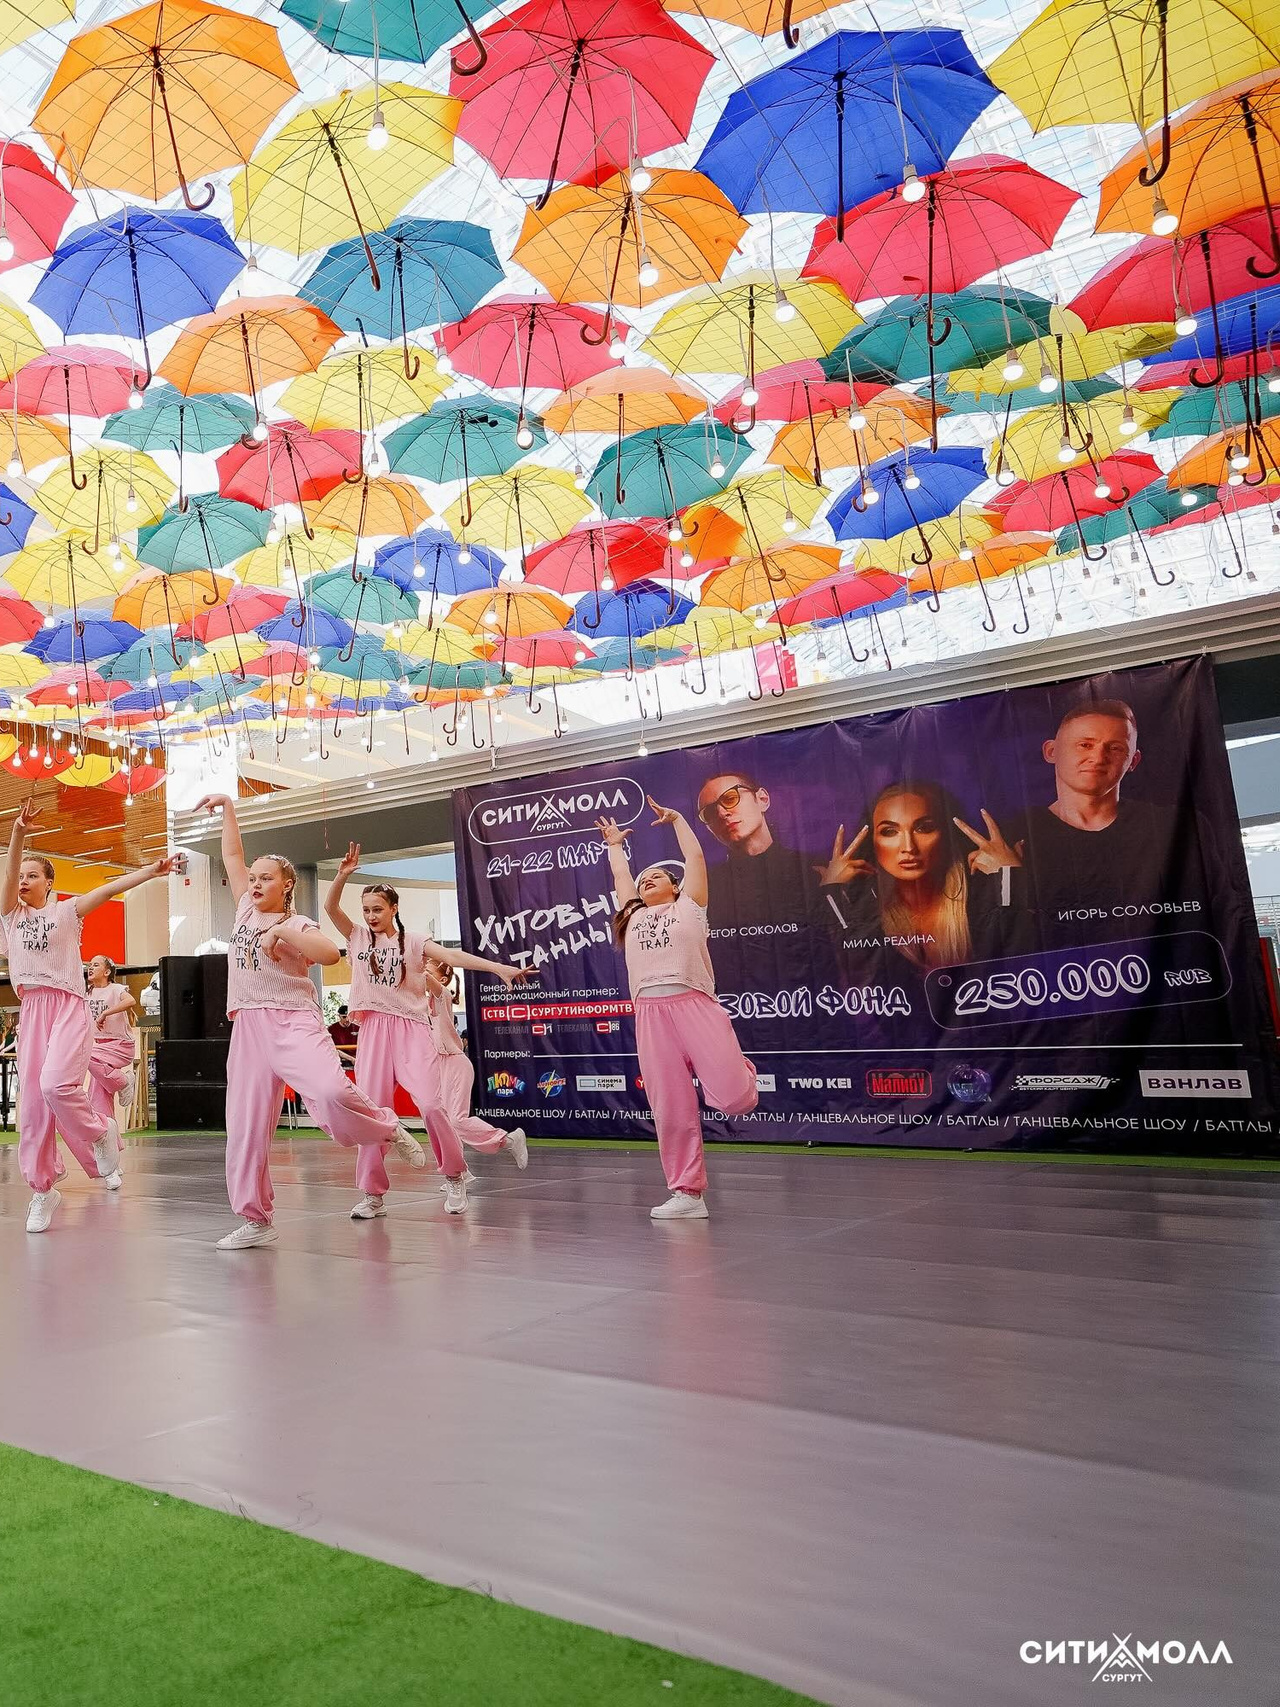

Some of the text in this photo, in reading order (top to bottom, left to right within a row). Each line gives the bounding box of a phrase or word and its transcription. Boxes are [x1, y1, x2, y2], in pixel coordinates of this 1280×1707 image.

[482, 789, 628, 826] СИТИ МОЛЛ
[536, 821, 564, 832] СУРГУТ
[486, 850, 554, 878] 21-22
[1058, 900, 1202, 922] ИГОРЬ СОЛОВЬЕВ
[42, 932, 48, 941] A
[637, 928, 669, 939] IT'S A
[710, 923, 798, 939] ЕГОР СОКОЛОВ
[23, 941, 49, 953] TRAP.
[639, 937, 673, 950] TRAP.
[843, 934, 936, 949] МИЛА РЕДИНА
[251, 948, 258, 958] A
[357, 951, 387, 964] GRW
[236, 958, 261, 971] TRP.
[389, 967, 395, 976] A
[954, 954, 1213, 1016] 250.000 RUB
[480, 987, 619, 1003] информационный партнер:
[717, 984, 912, 1018] ЗОВОЙ ФОНД
[484, 1049, 531, 1059] Партнеры:
[788, 1078, 852, 1089] TWO KEI
[1147, 1077, 1242, 1090] ванлав
[475, 1108, 541, 1118] ТАНЦЕВАЛЬНОЕ
[542, 1109, 566, 1119] ШОУ
[574, 1110, 610, 1119] БАТТЛЫ
[703, 1112, 730, 1122] ШОУ
[797, 1113, 895, 1125] ТАНЦЕВАЛЬНОЕ
[899, 1115, 933, 1126] ШОУ
[947, 1115, 999, 1127] БАТТЛЫ
[1013, 1116, 1139, 1130] ТАНЦЕВАЛЬНОЕ
[1144, 1119, 1186, 1131] ШОУ
[1205, 1119, 1272, 1133] БАТТЛЫ
